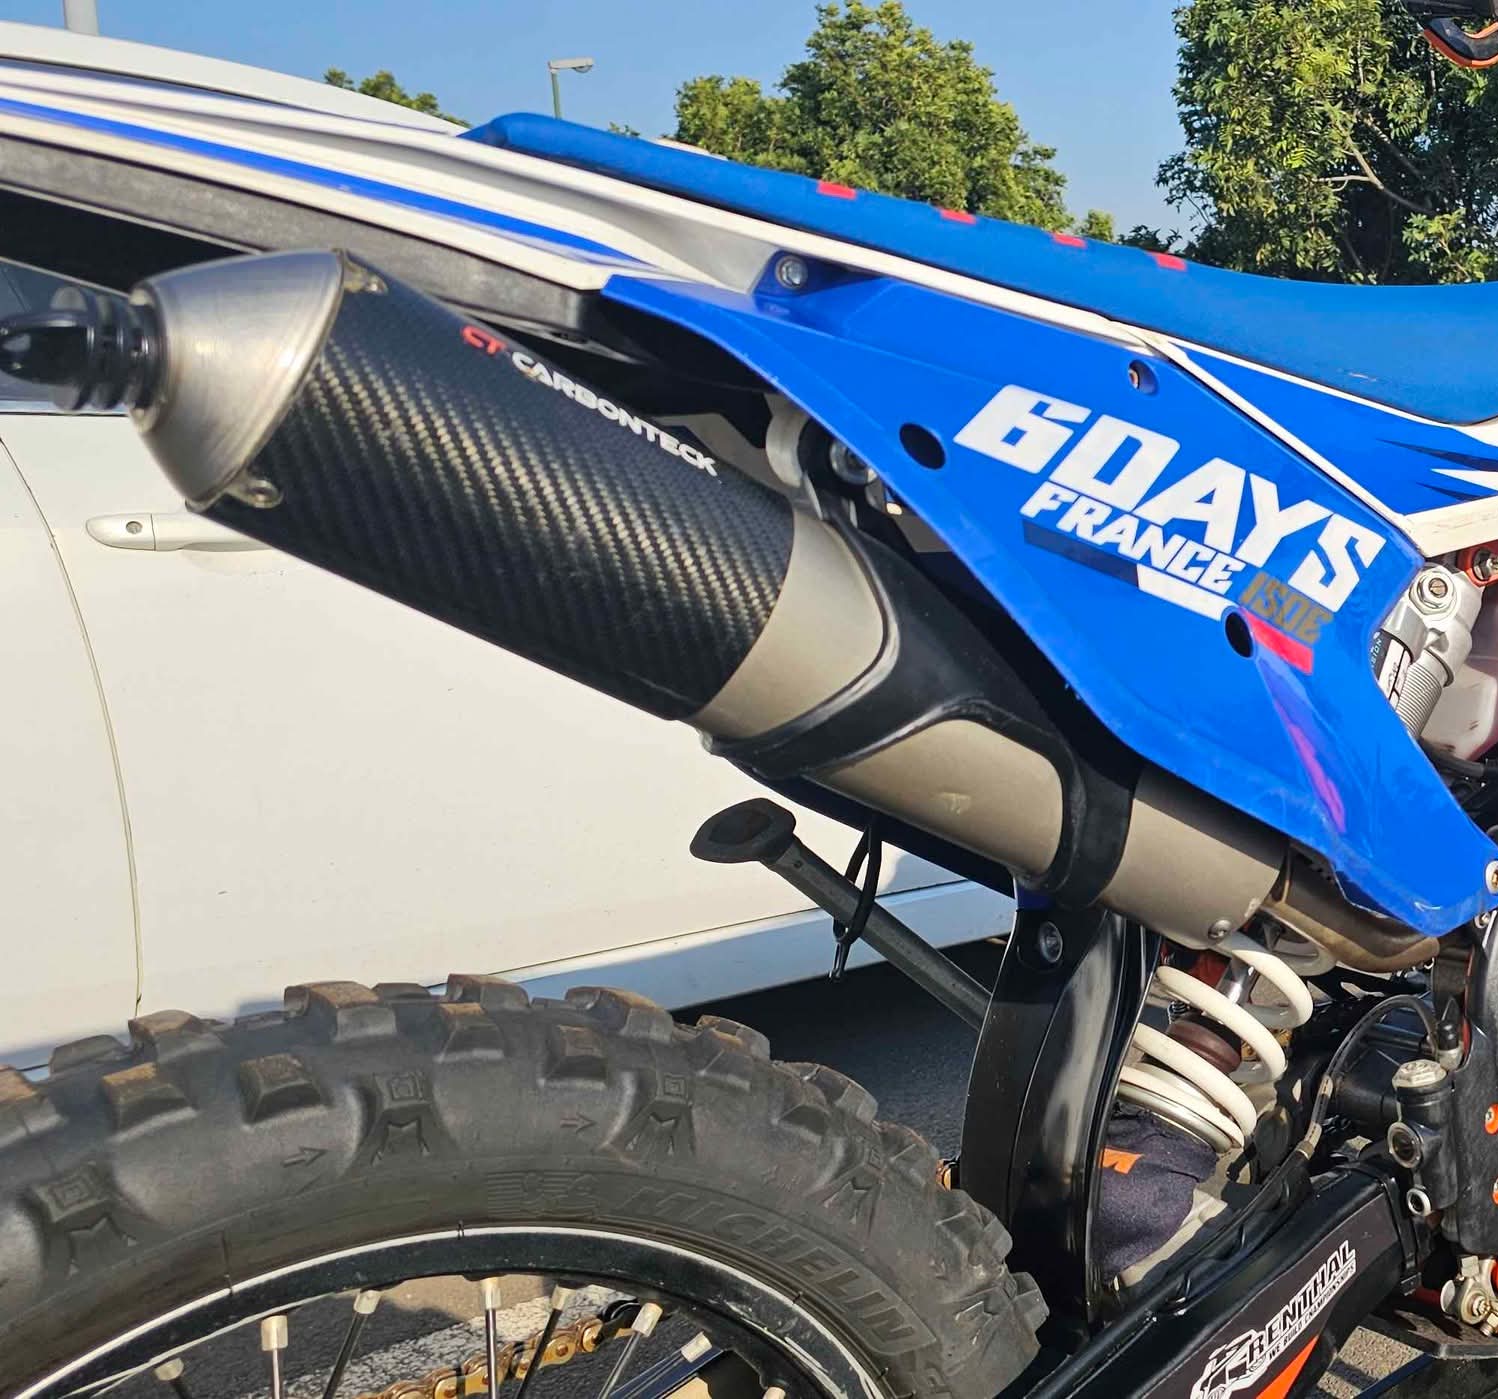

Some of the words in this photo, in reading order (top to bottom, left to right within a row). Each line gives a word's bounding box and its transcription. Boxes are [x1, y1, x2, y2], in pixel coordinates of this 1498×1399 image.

[511, 351, 719, 477] CARBONTECK
[1019, 480, 1246, 595] FRANCE
[1238, 572, 1335, 644] ISDE
[620, 1184, 918, 1343] MICHELIN
[1248, 1240, 1356, 1364] RENTHAL
